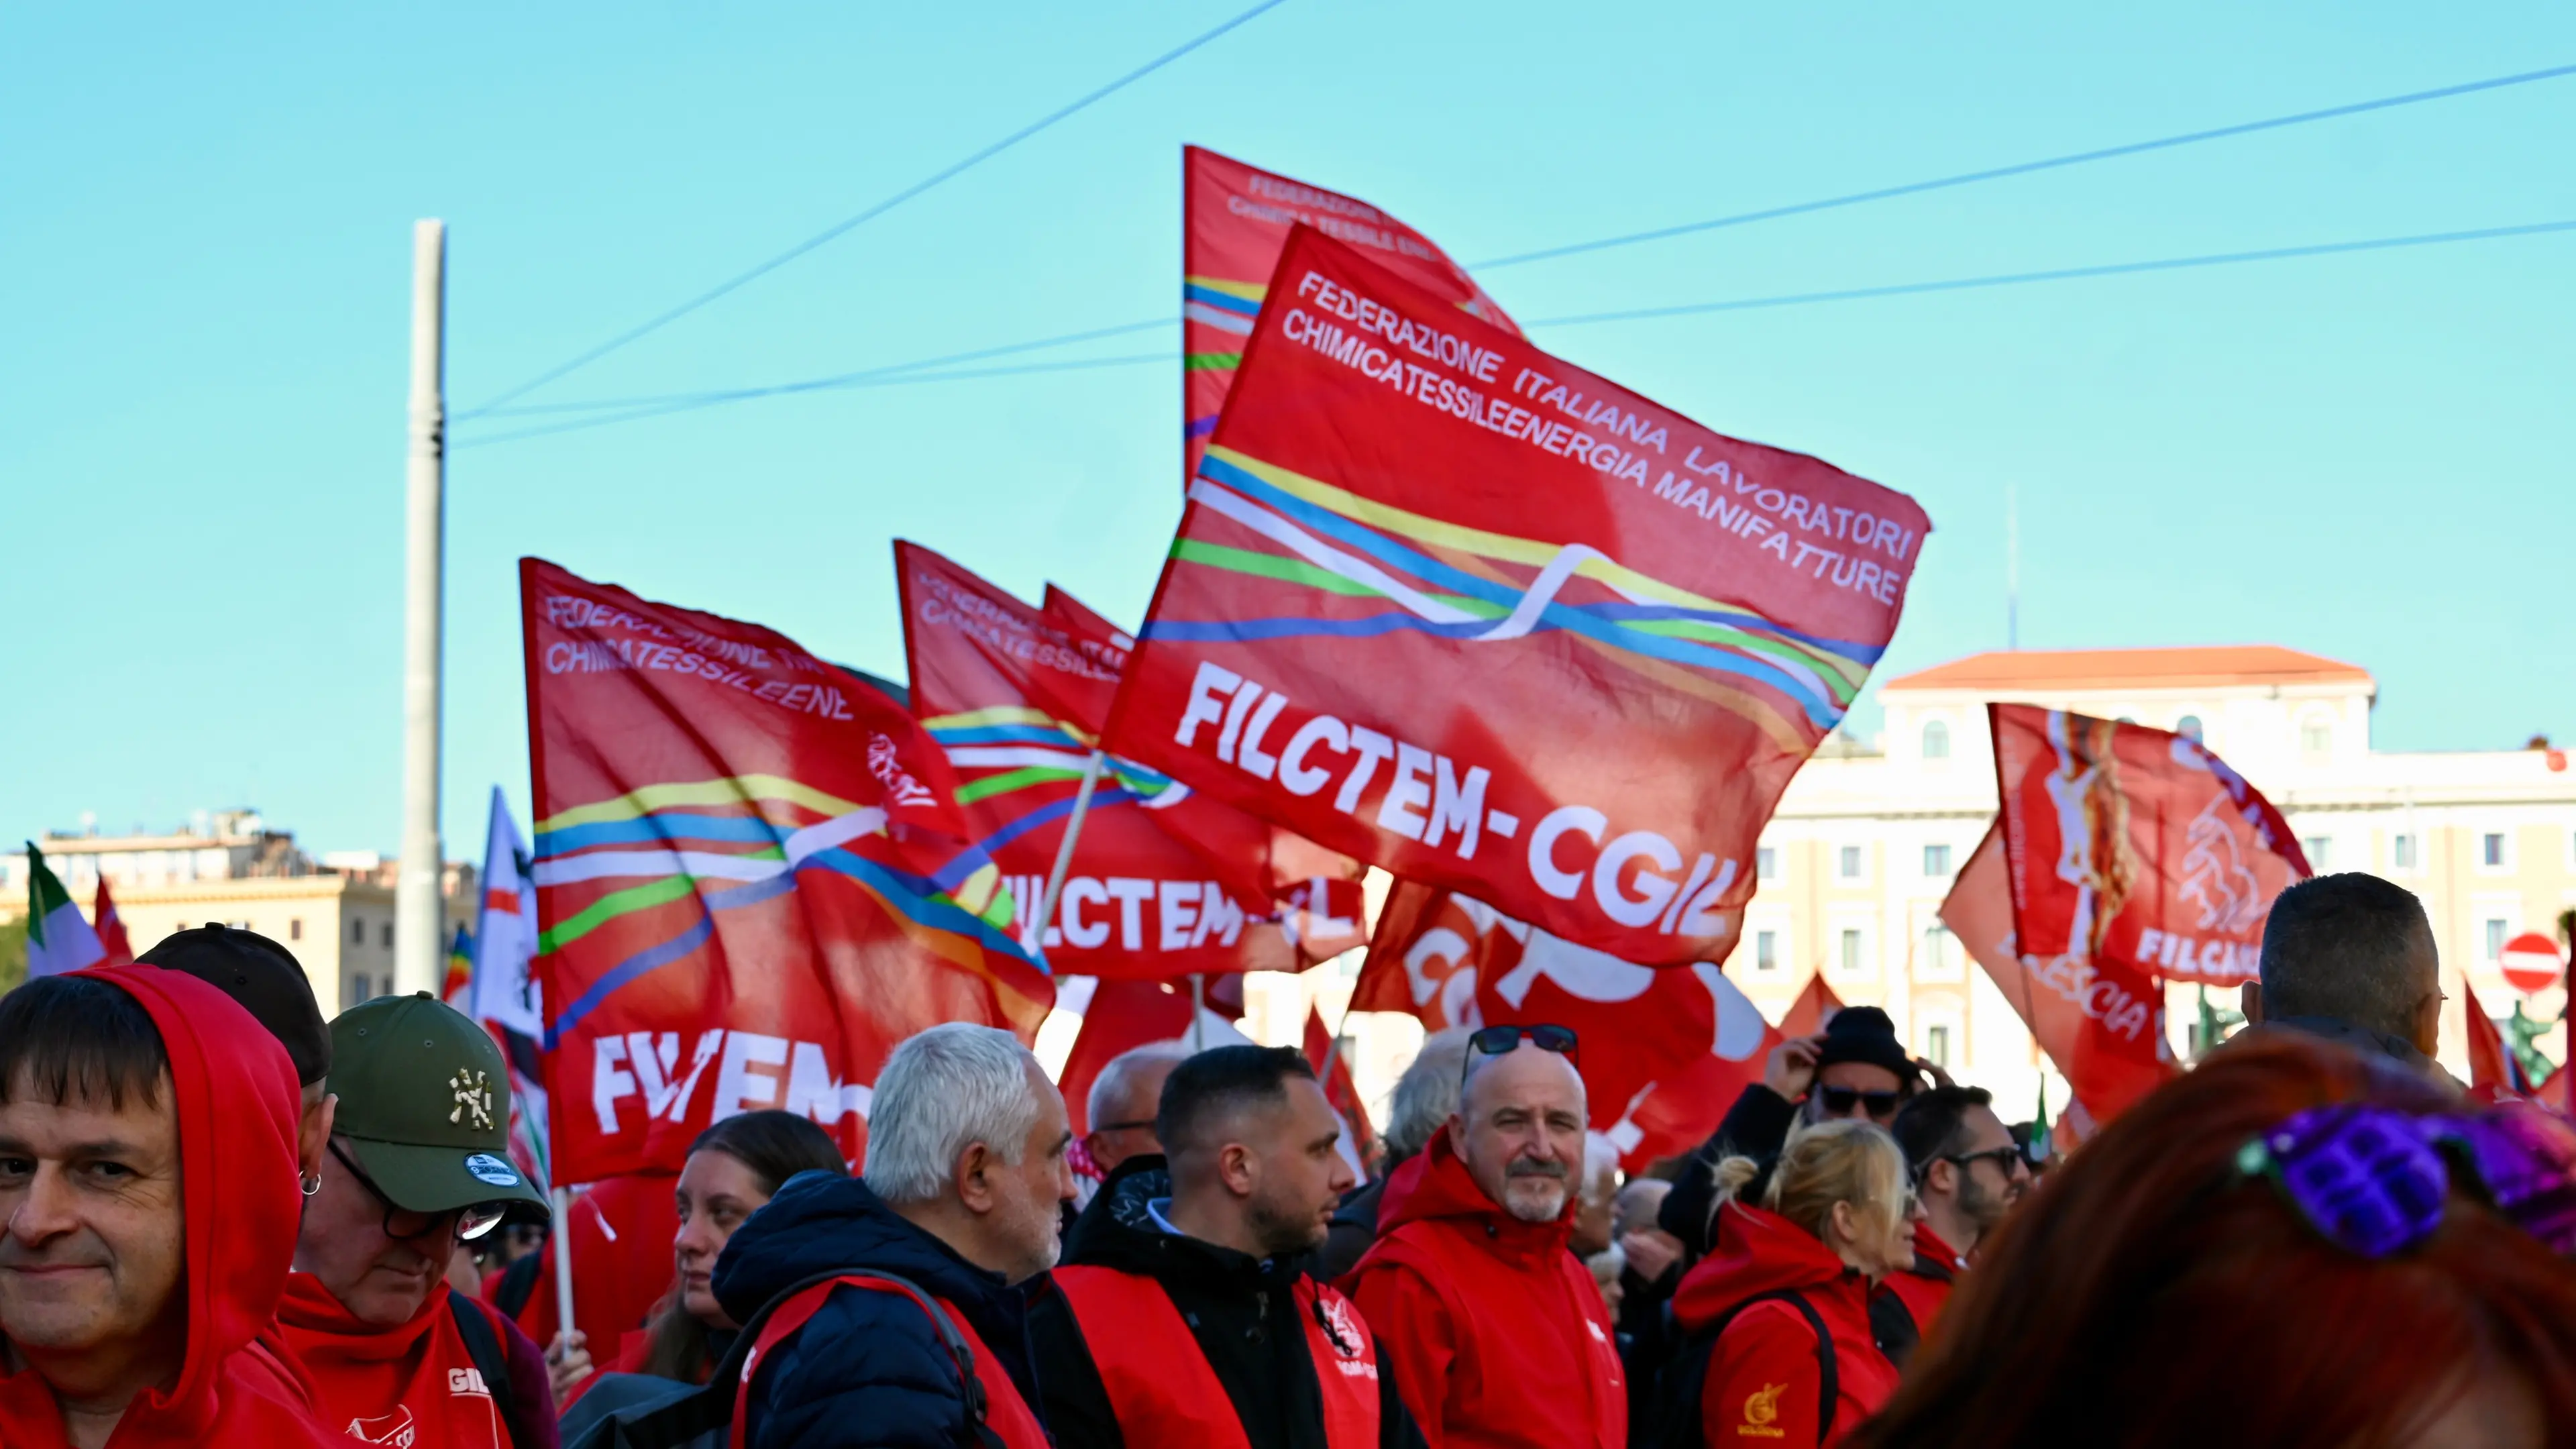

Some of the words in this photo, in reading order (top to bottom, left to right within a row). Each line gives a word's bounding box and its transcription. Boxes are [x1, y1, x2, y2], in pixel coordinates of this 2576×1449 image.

[1282, 308, 1648, 487] CHIMICATESSILEENERGIA
[1652, 471, 1902, 606] MANIFATTURE
[1297, 270, 1504, 382] FEDERAZIONE
[1512, 368, 1668, 454] ITALIANA
[1683, 445, 1914, 561] LAVORATORI
[1174, 660, 1738, 936] FILCTEM-CGIL
